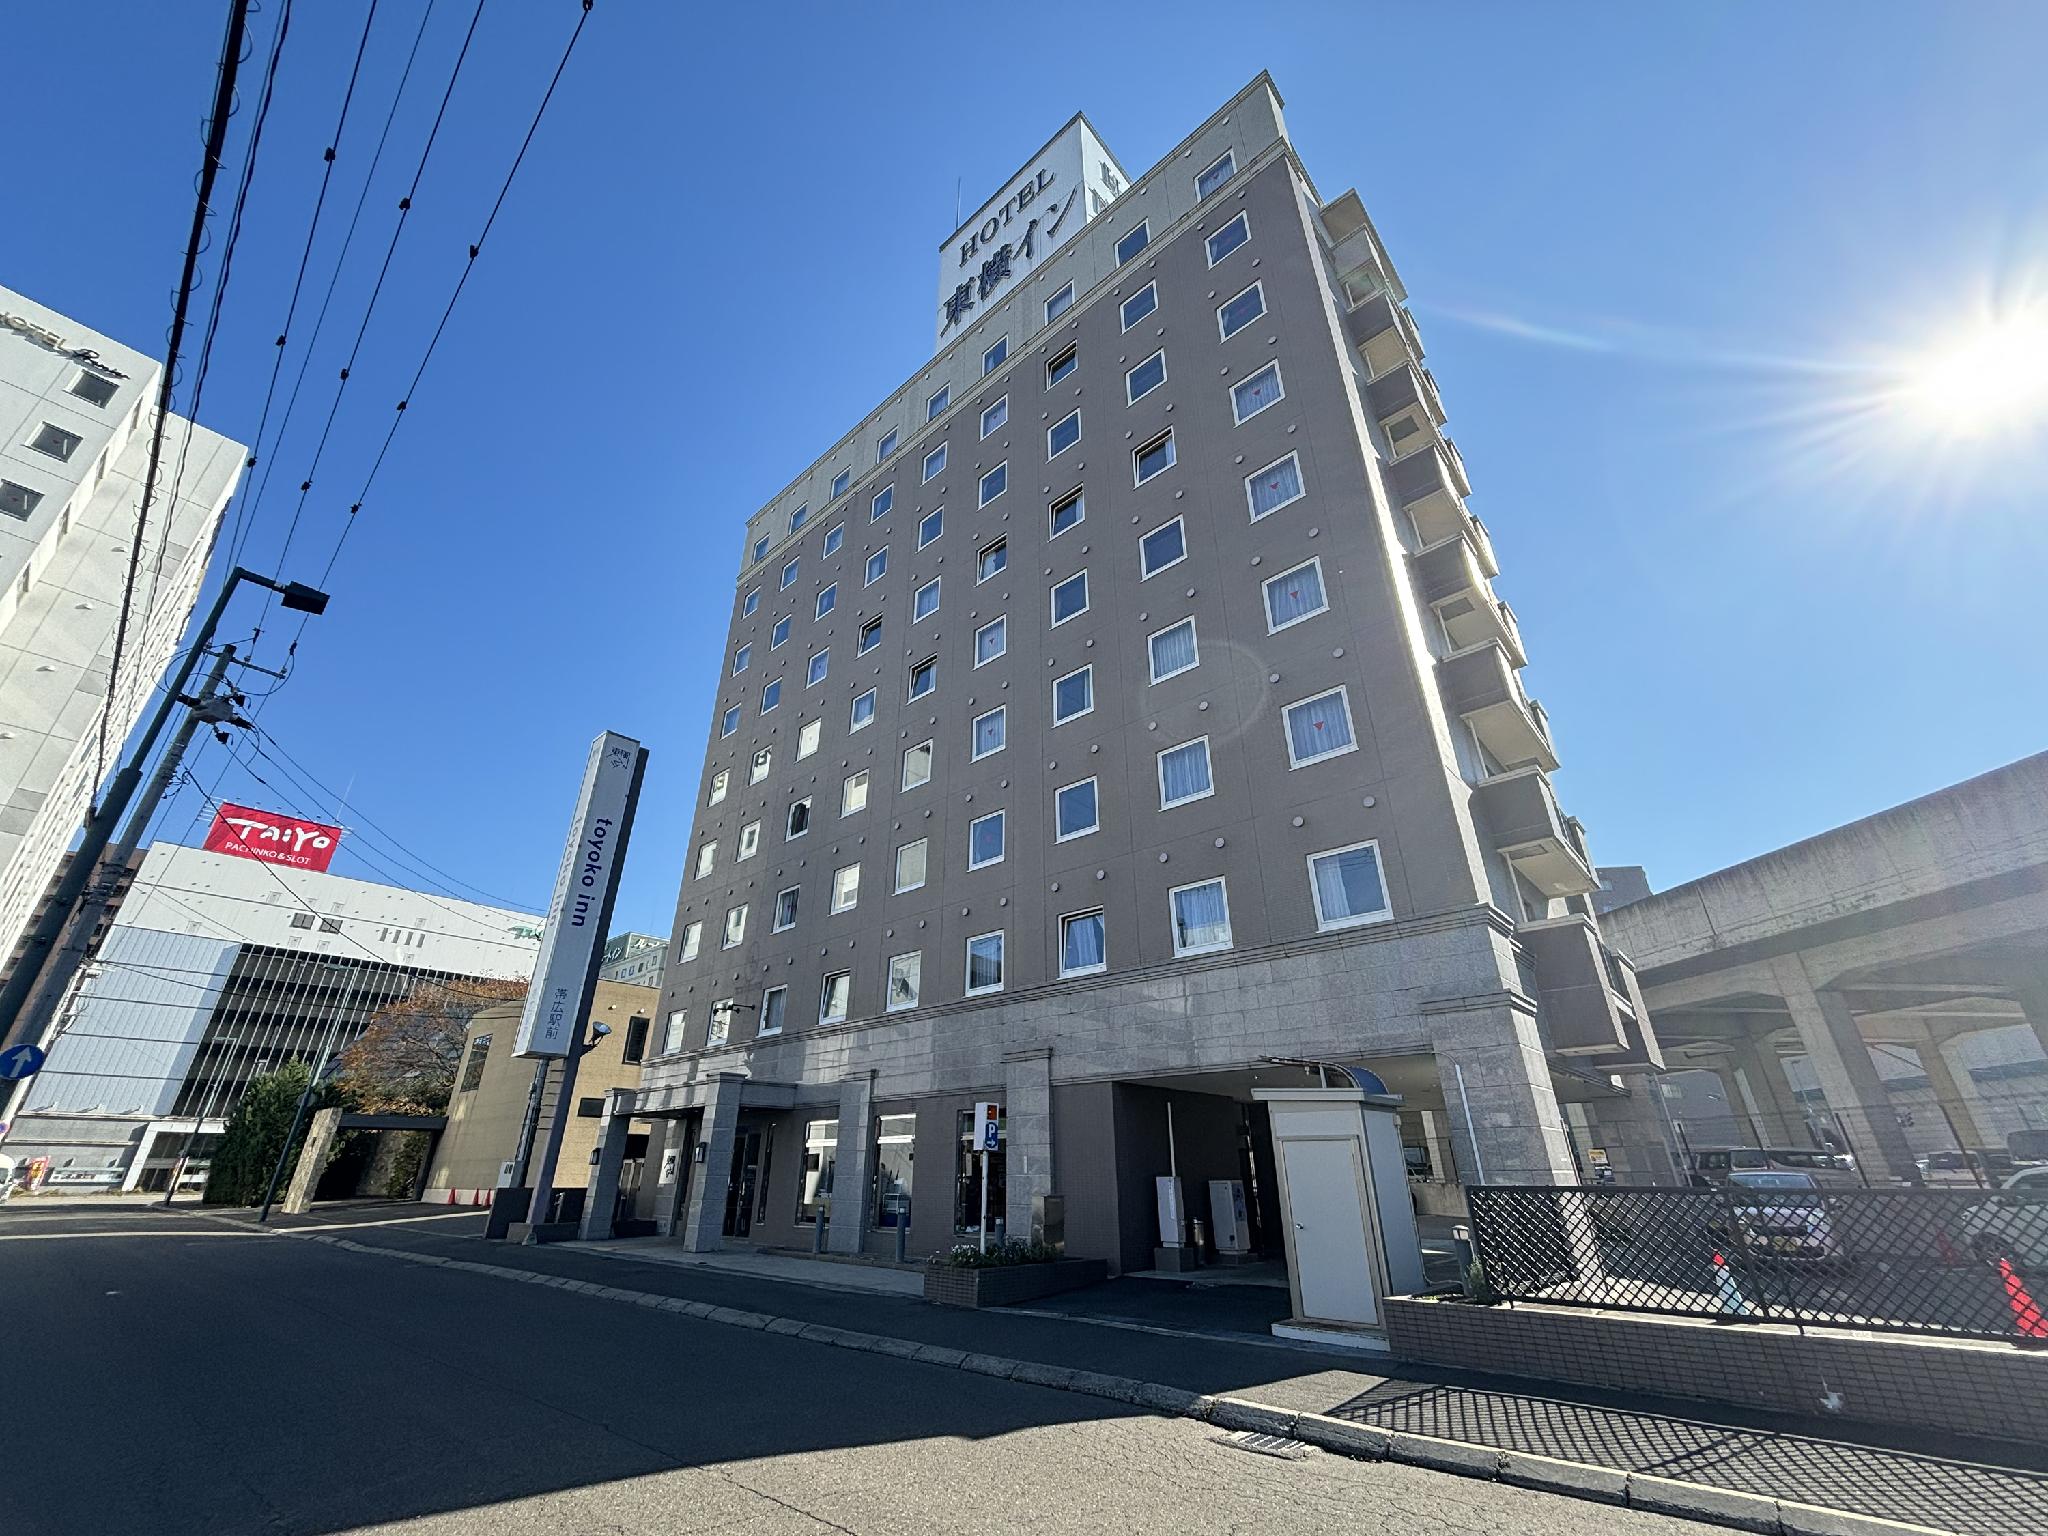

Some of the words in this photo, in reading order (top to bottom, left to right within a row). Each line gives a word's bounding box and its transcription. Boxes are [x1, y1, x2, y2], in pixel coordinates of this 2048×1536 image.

[960, 168, 1056, 268] HOTEL
[224, 841, 277, 858] PACHINKO
[286, 853, 312, 866] SLOT
[581, 818, 613, 887] toyoko
[571, 893, 596, 927] inn
[988, 1123, 996, 1138] P
